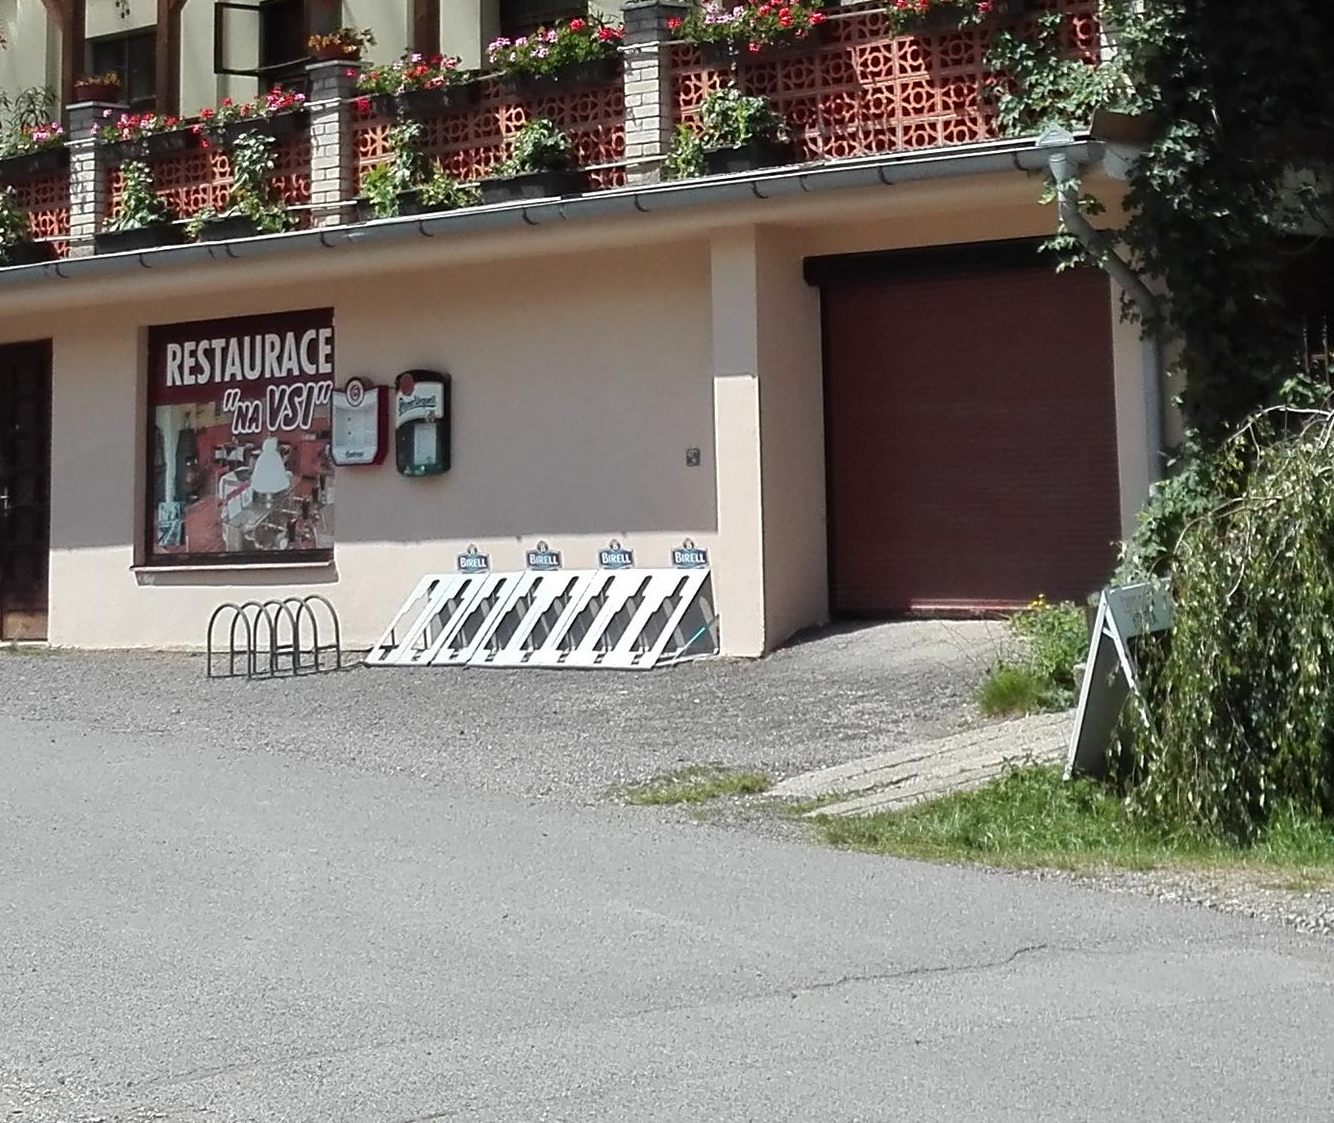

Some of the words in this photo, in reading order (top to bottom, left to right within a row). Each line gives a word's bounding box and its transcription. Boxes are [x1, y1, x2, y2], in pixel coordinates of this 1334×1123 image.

[166, 328, 333, 386] RESTAURACE
[460, 557, 487, 567] BIRELL
[530, 554, 558, 565] BIRELL
[601, 552, 631, 563] BIRELL
[675, 551, 706, 563] BIRELL
